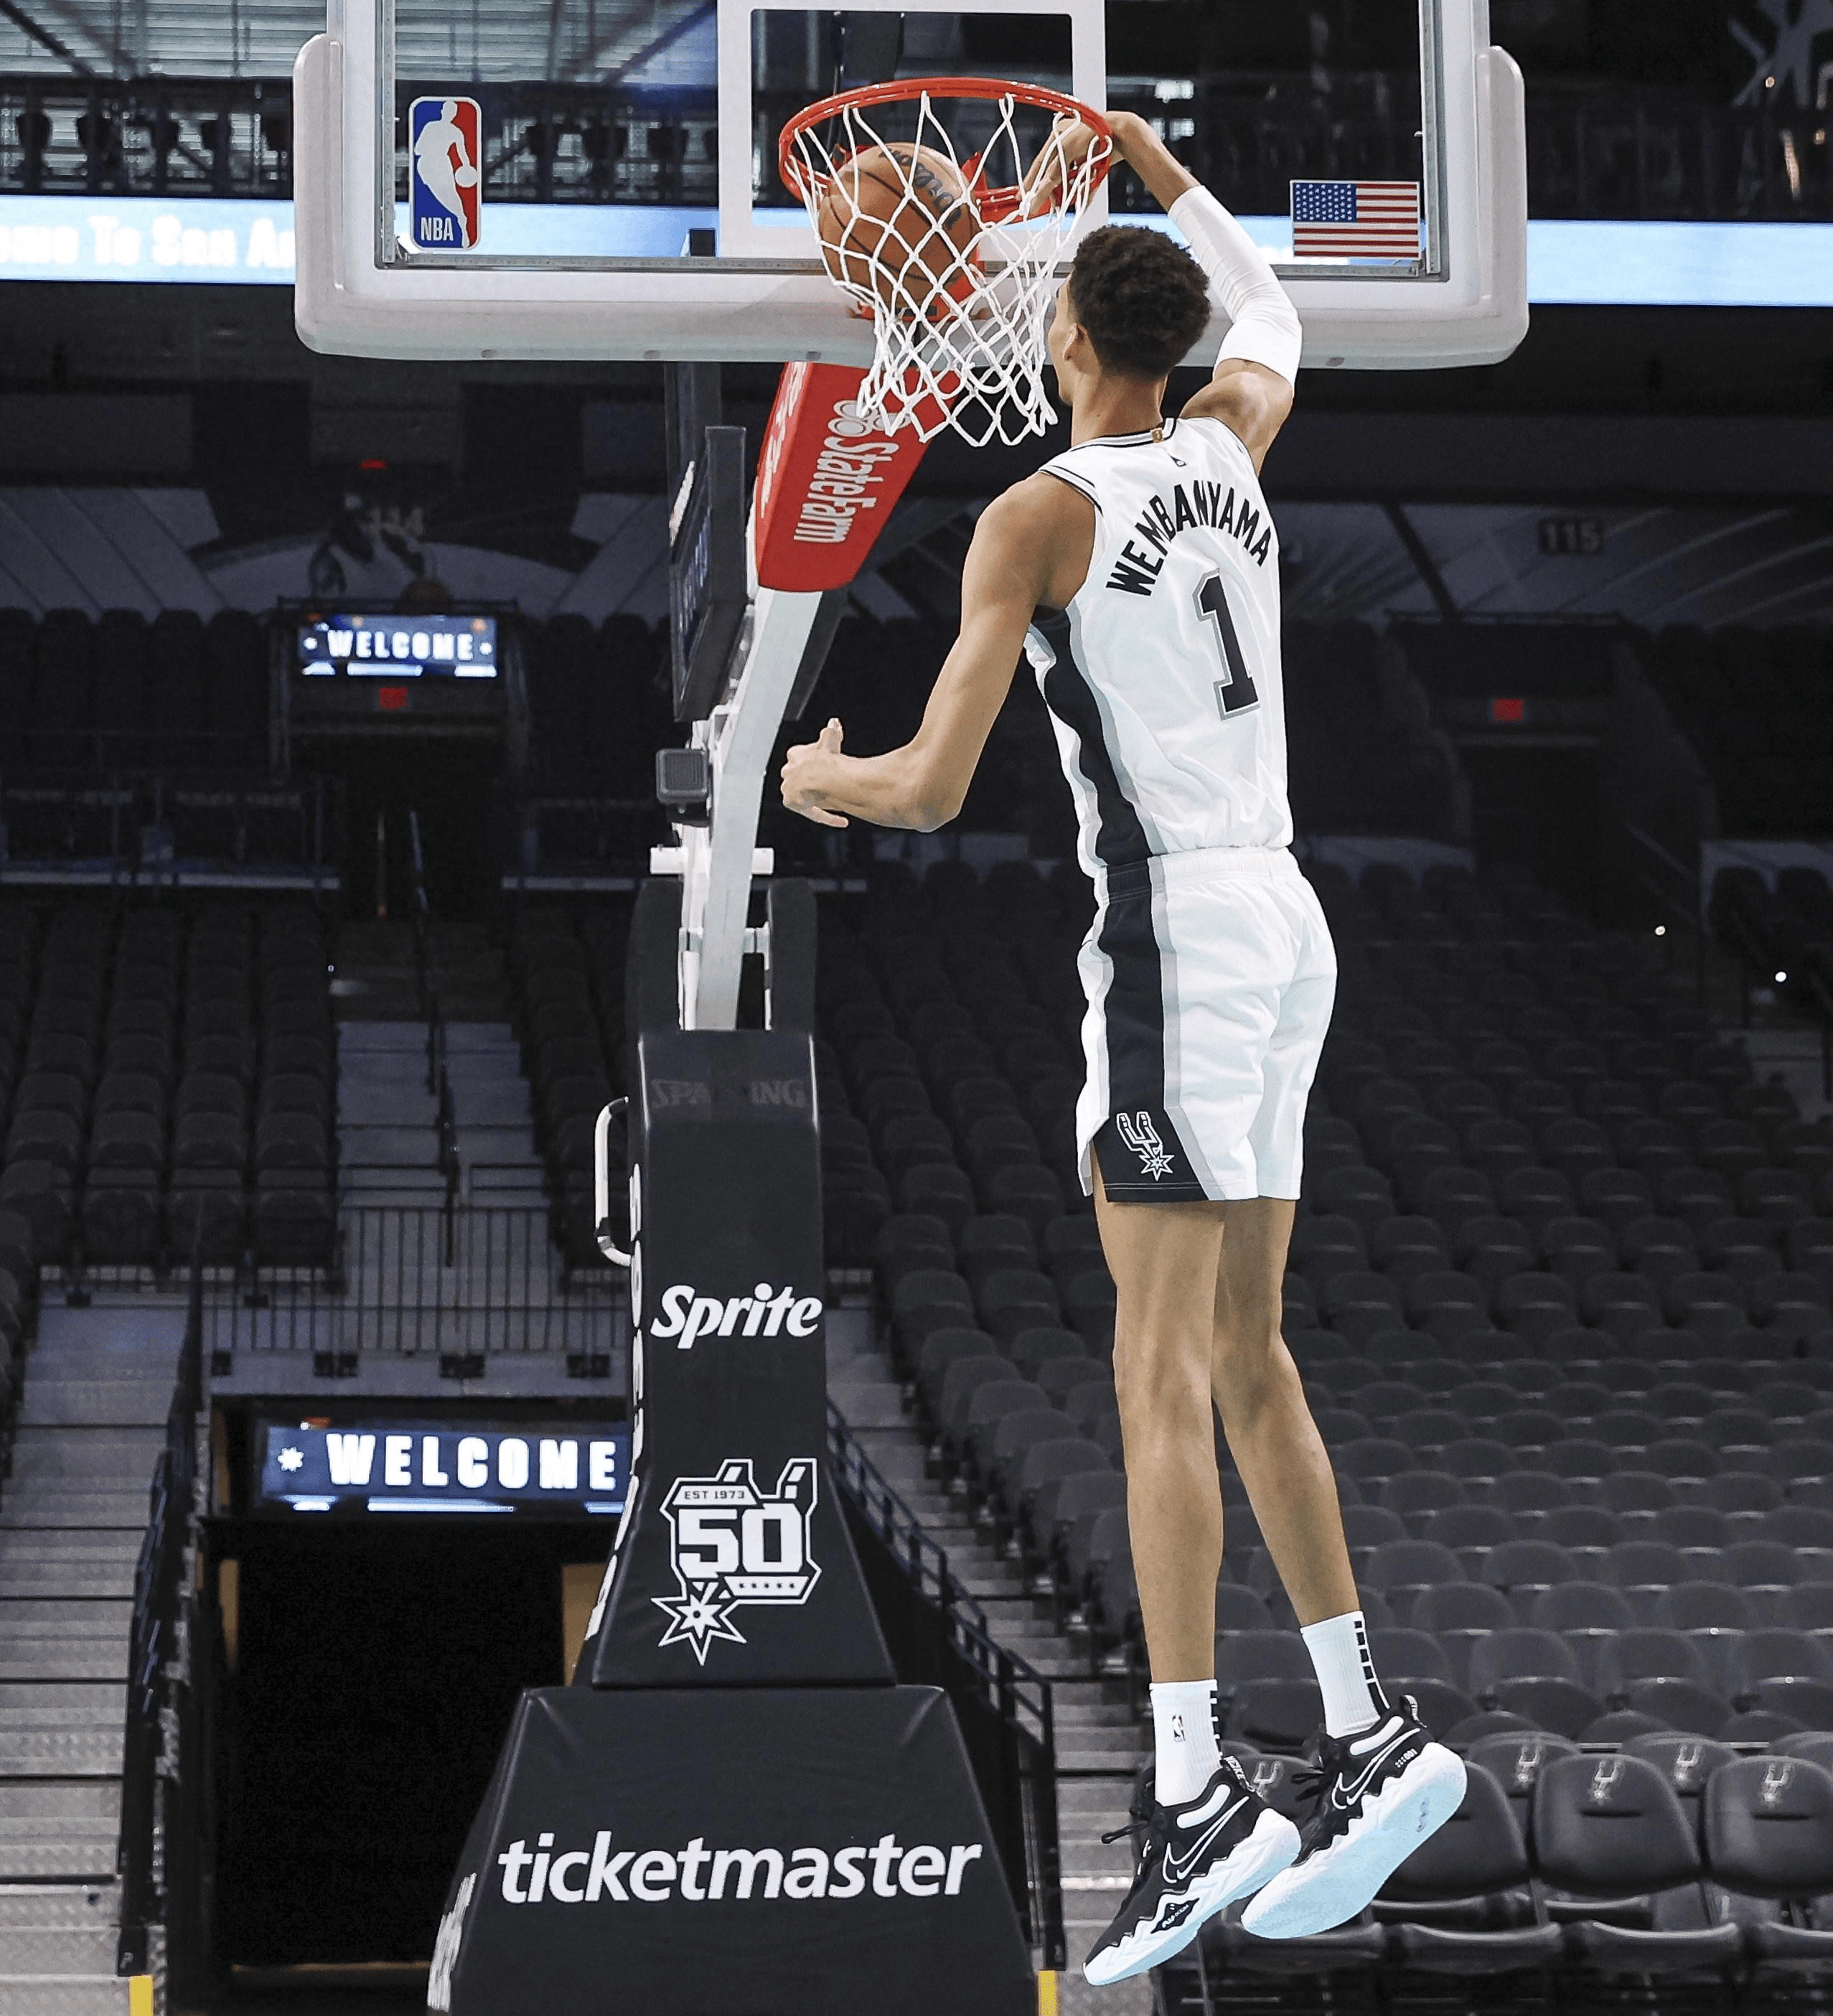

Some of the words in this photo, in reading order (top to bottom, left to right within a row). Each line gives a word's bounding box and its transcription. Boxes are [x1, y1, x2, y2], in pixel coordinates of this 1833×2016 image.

[421, 217, 454, 241] NBA
[1106, 480, 1271, 596] WEMBANYAMA
[327, 630, 474, 660] WELCOME
[1193, 568, 1260, 720] 1
[650, 1283, 822, 1349] Sprite
[326, 1433, 615, 1489] WELCOME
[684, 1491, 708, 1500] EST
[714, 1490, 745, 1499] 1973
[678, 1503, 802, 1578] 50
[497, 1830, 983, 1903] ticketmaster
